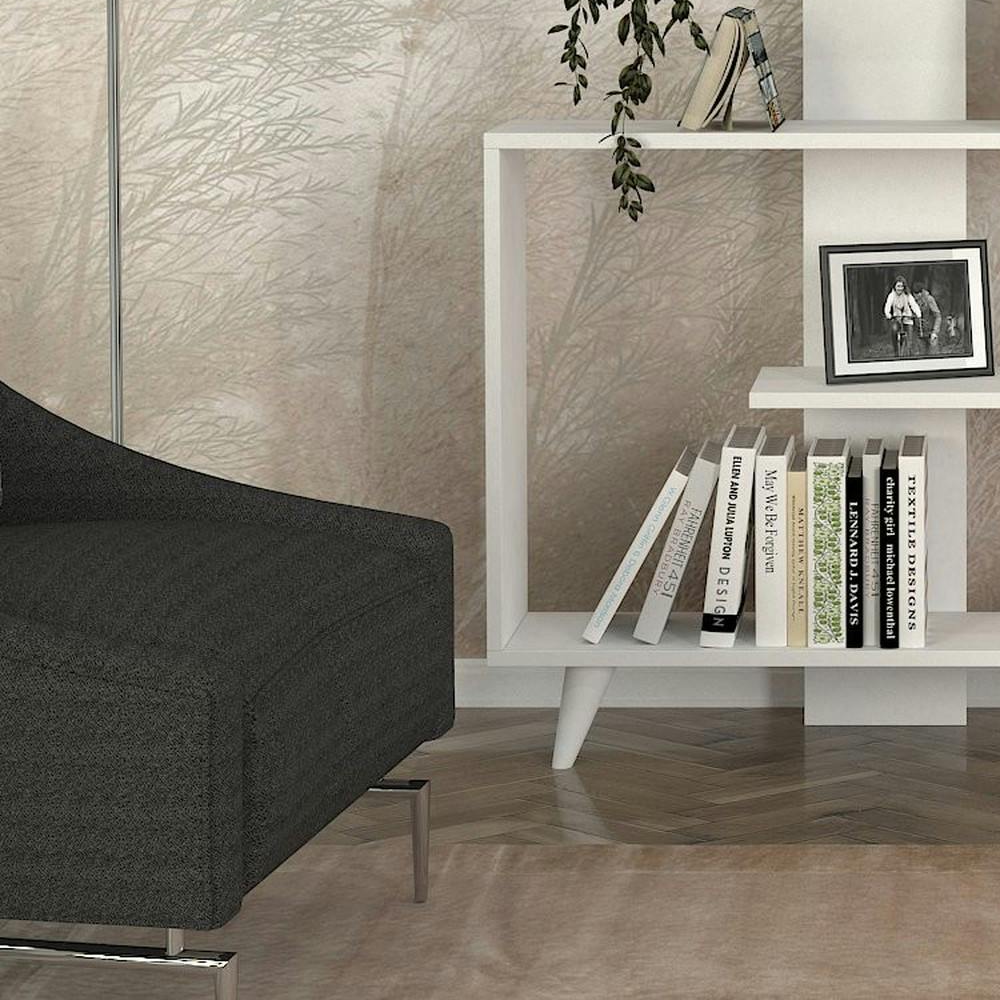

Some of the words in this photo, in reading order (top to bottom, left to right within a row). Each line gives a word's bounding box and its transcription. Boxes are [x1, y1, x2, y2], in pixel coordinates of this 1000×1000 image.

[731, 456, 742, 480] ELLEN
[762, 469, 777, 493] May
[728, 481, 737, 500] AND
[765, 495, 776, 511] We
[885, 477, 896, 515] charity
[676, 500, 691, 522] RAY
[726, 502, 736, 525] JULIA
[765, 514, 777, 528] Be
[884, 517, 896, 536] girl
[907, 474, 916, 549] TEXTILE
[672, 507, 702, 569] FAHRENHEIT
[722, 527, 733, 560] LUPTON
[762, 530, 778, 573] Forgiven
[849, 502, 858, 567] LENNARD
[871, 503, 880, 565] FAHRENHEIT
[653, 528, 682, 597] BRADBURY
[848, 570, 858, 581] J.
[886, 544, 896, 585] michael
[660, 570, 680, 598] 451
[712, 567, 730, 627] DESIGN
[871, 567, 880, 598] 451
[907, 554, 916, 631] DESIGNS
[849, 584, 858, 625] DAVIS
[886, 588, 896, 639] lowenthal
